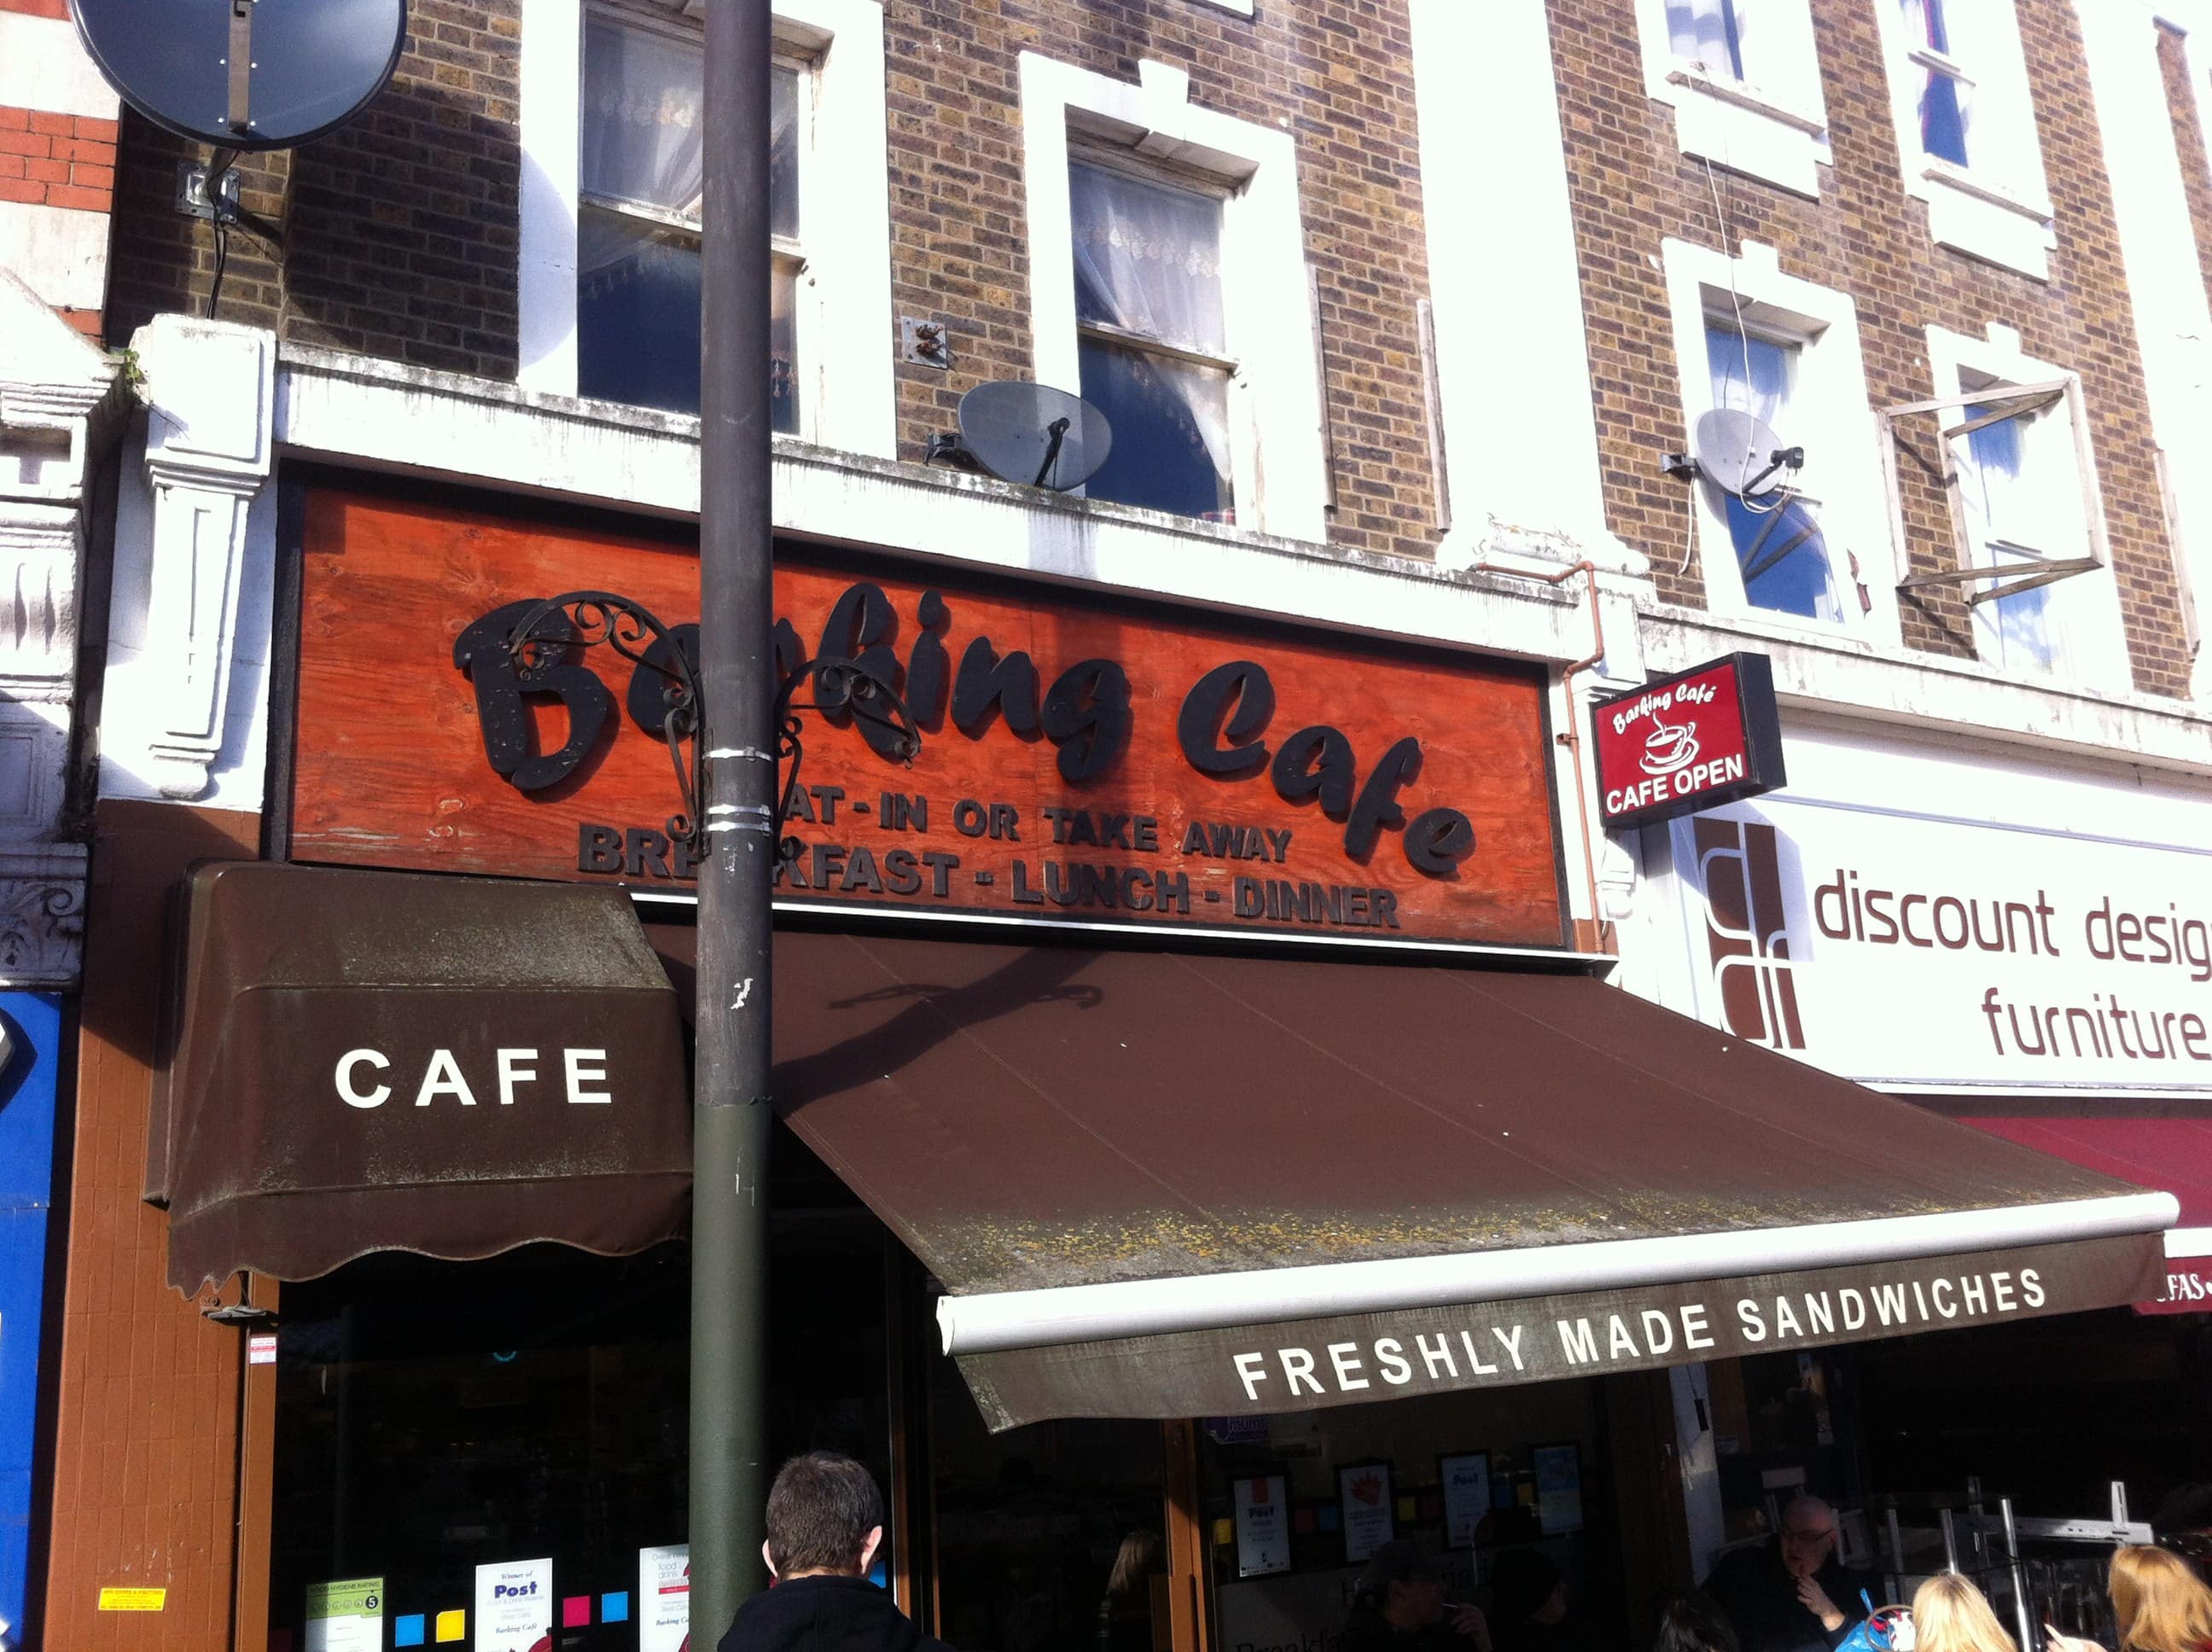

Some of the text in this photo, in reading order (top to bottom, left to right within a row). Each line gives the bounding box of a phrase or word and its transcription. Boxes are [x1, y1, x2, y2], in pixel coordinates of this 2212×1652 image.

[1612, 683, 1717, 735] Barking Café
[1178, 660, 1475, 875] Cafe
[1606, 753, 1743, 814] CAFE OPEN
[953, 799, 1020, 841] OR
[1043, 806, 1159, 852] TAKE
[1181, 821, 1293, 863] AWAY
[1010, 859, 1190, 913] LUNCH
[1232, 876, 1400, 928] DINNER
[1814, 868, 2212, 982] discount desig
[1982, 986, 2212, 1061] furniture
[336, 1050, 611, 1108] CAFE
[1232, 1268, 2046, 1400] FRESHLY MADE SANDWICHES
[495, 1581, 538, 1598] Post
